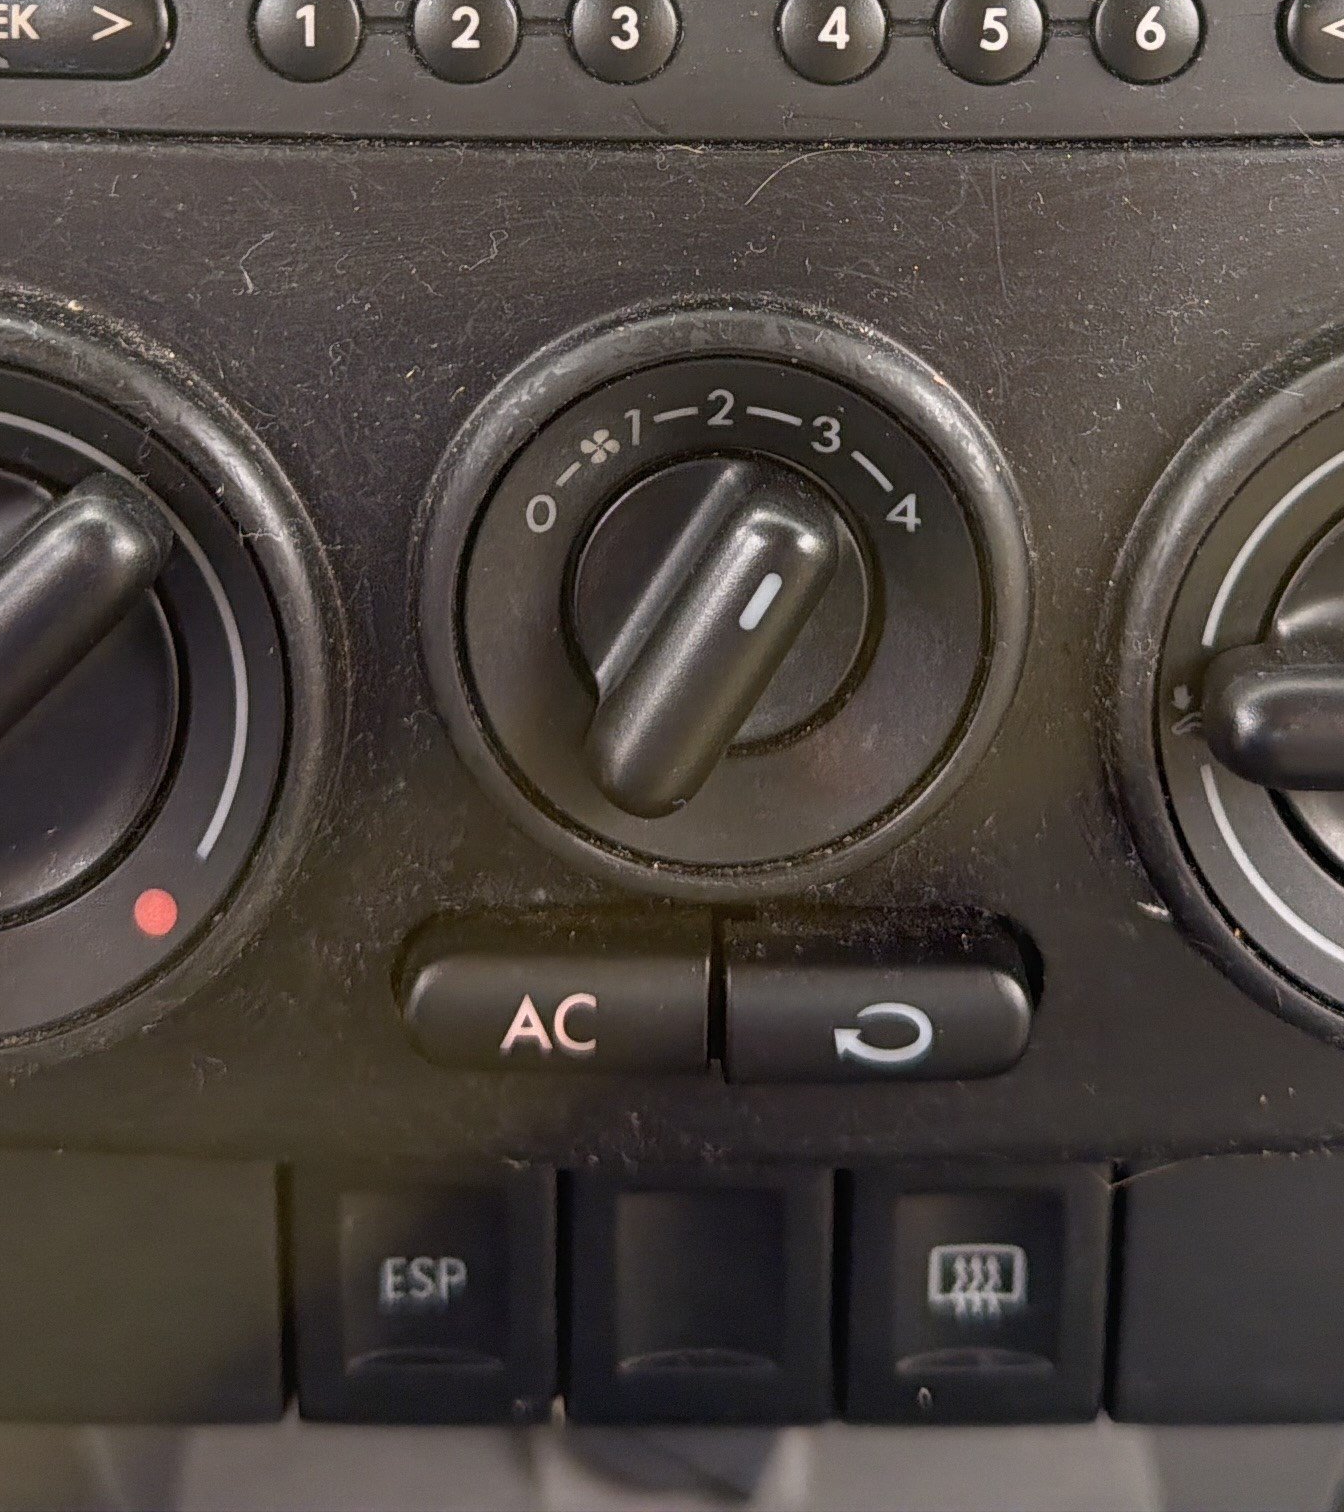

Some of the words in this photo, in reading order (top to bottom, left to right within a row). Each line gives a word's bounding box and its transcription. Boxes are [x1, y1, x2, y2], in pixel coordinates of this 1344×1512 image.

[295, 5, 317, 48] 1
[451, 6, 481, 50] 2
[610, 6, 640, 50] 3
[817, 6, 850, 50] 4
[979, 6, 1009, 51] 5
[1135, 6, 1167, 50] 6
[624, 409, 641, 446] 1
[706, 388, 735, 426] 2
[810, 415, 842, 454] 3
[525, 494, 556, 533] 0
[885, 493, 922, 532] 4
[499, 992, 597, 1055] AC
[379, 1256, 467, 1304] ESP
